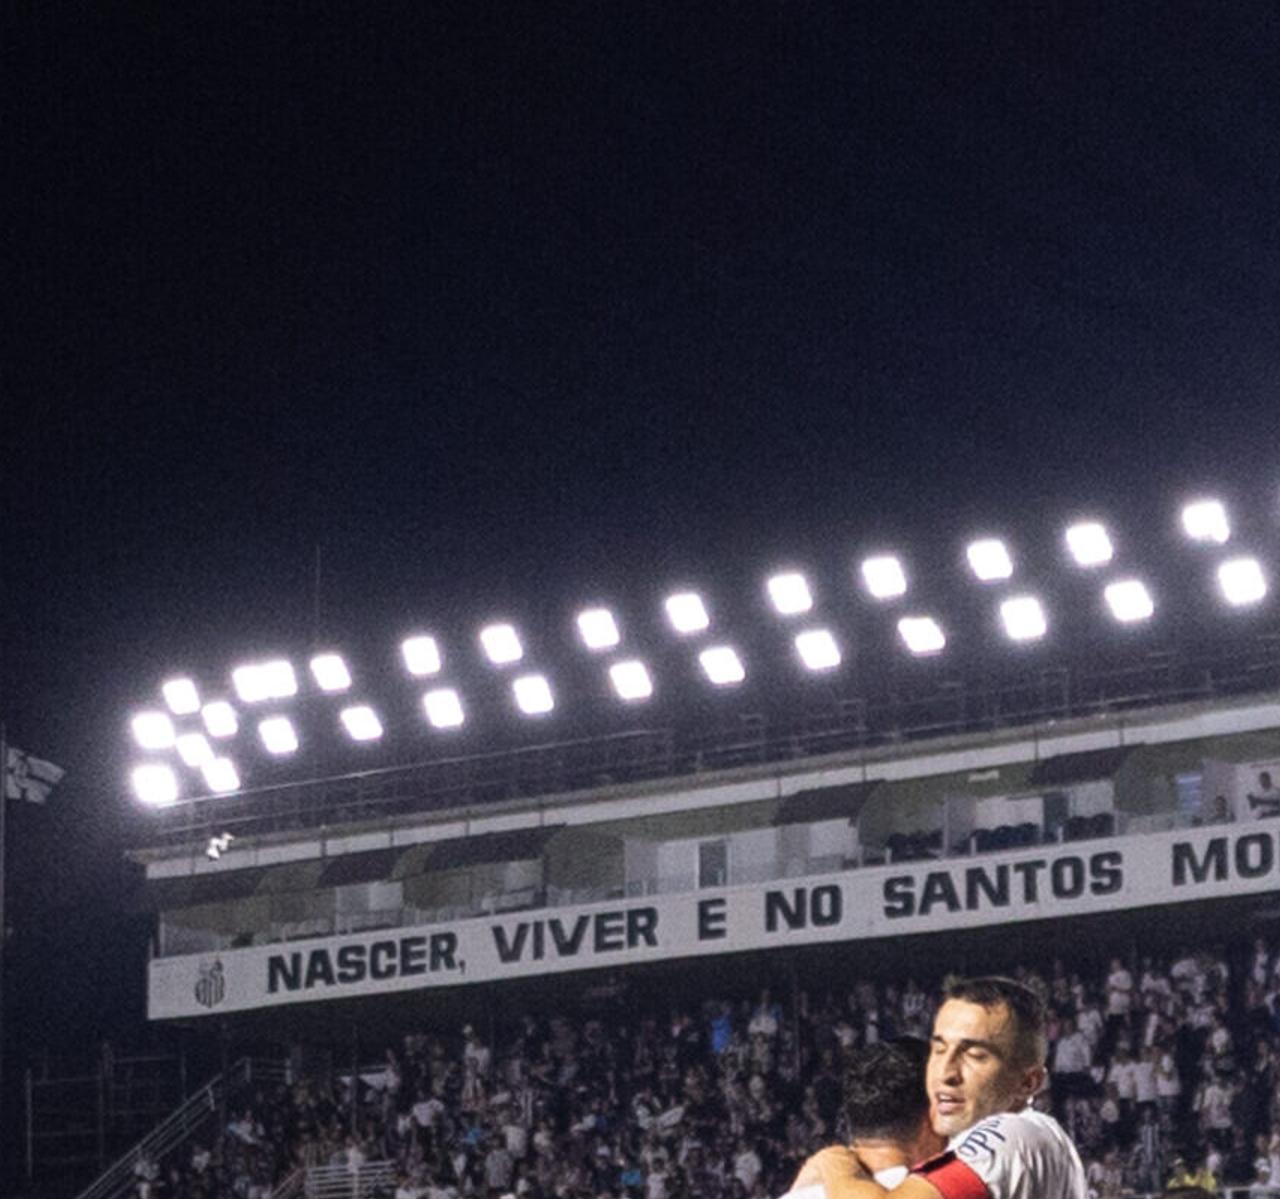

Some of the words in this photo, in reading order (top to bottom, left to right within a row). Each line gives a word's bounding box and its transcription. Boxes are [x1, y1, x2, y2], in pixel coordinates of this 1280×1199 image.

[266, 932, 466, 994] NASCER,
[493, 906, 659, 964] VIVER
[697, 899, 727, 940] E
[765, 883, 843, 932] NO
[883, 851, 1124, 919] SANTOS
